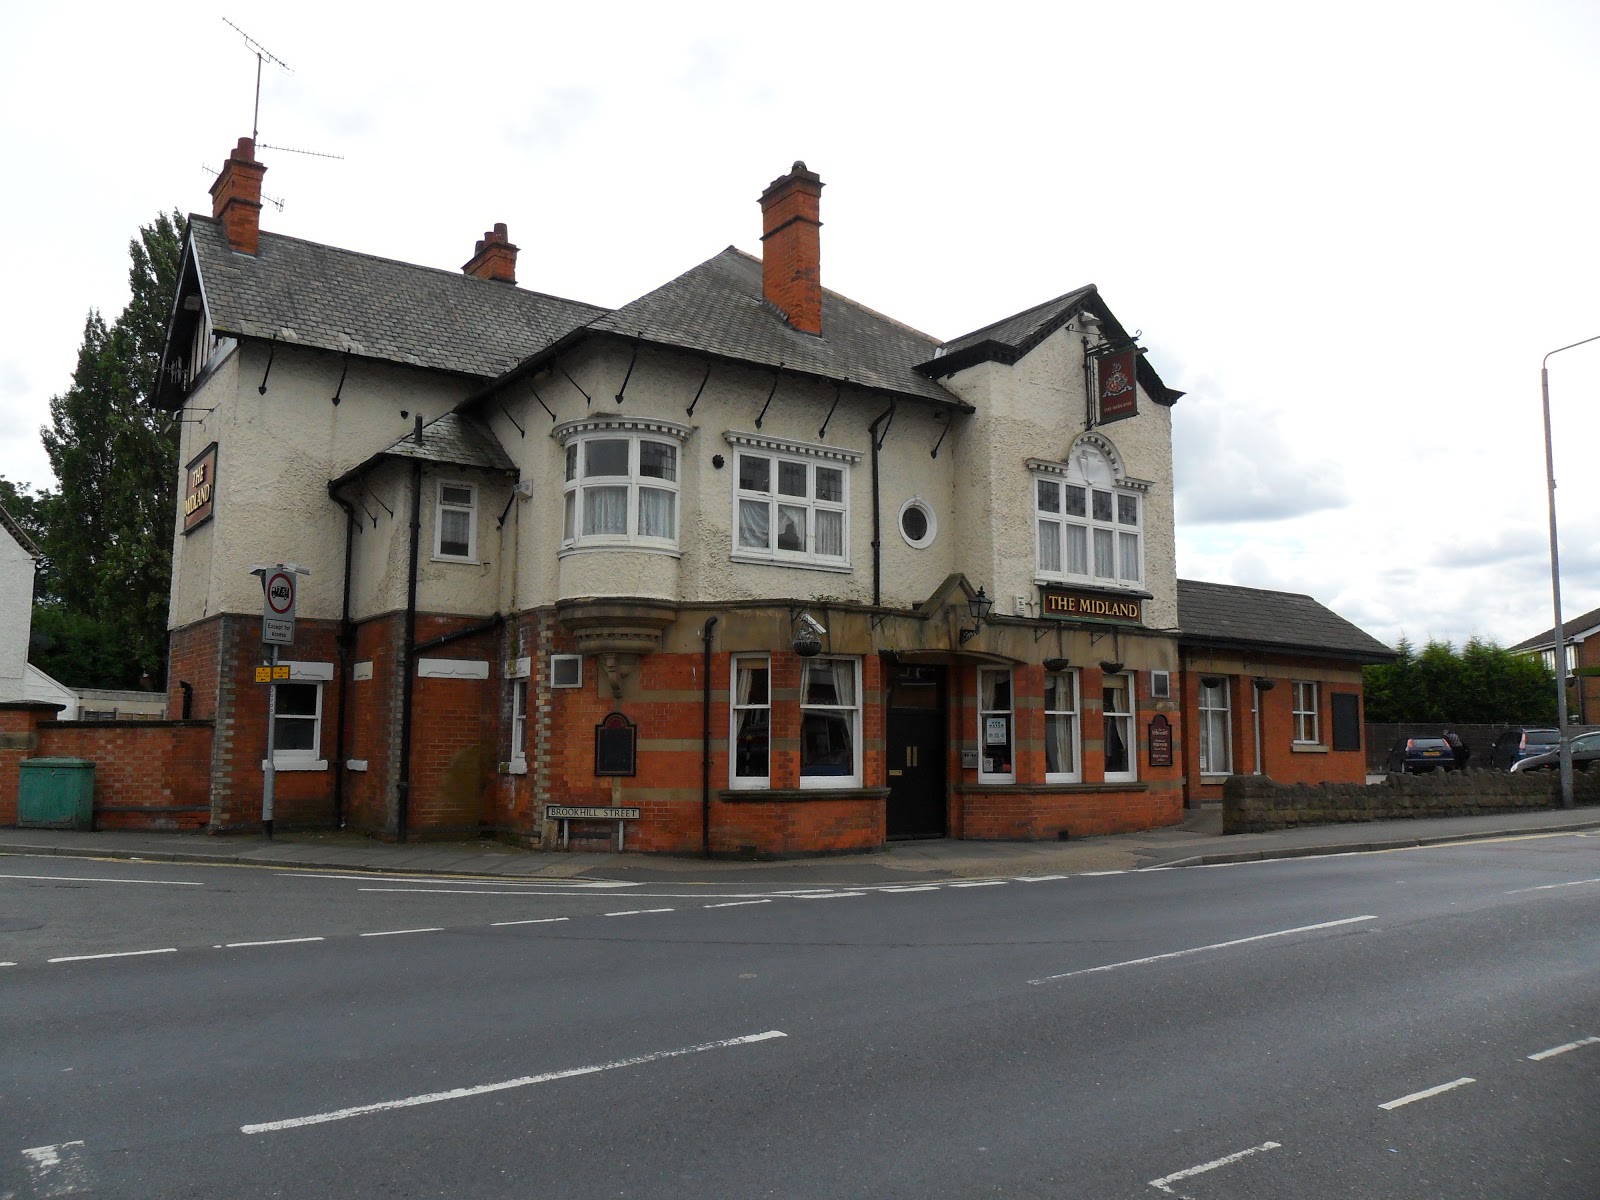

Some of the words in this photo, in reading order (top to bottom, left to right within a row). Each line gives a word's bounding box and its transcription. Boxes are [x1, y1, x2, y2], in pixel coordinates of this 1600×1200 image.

[192, 463, 206, 488] THE
[1048, 595, 1075, 611] THE
[1079, 599, 1138, 617] MIDLAND
[268, 623, 283, 632] Except
[551, 808, 598, 817] BROOKHILL
[603, 809, 637, 818] STREET
